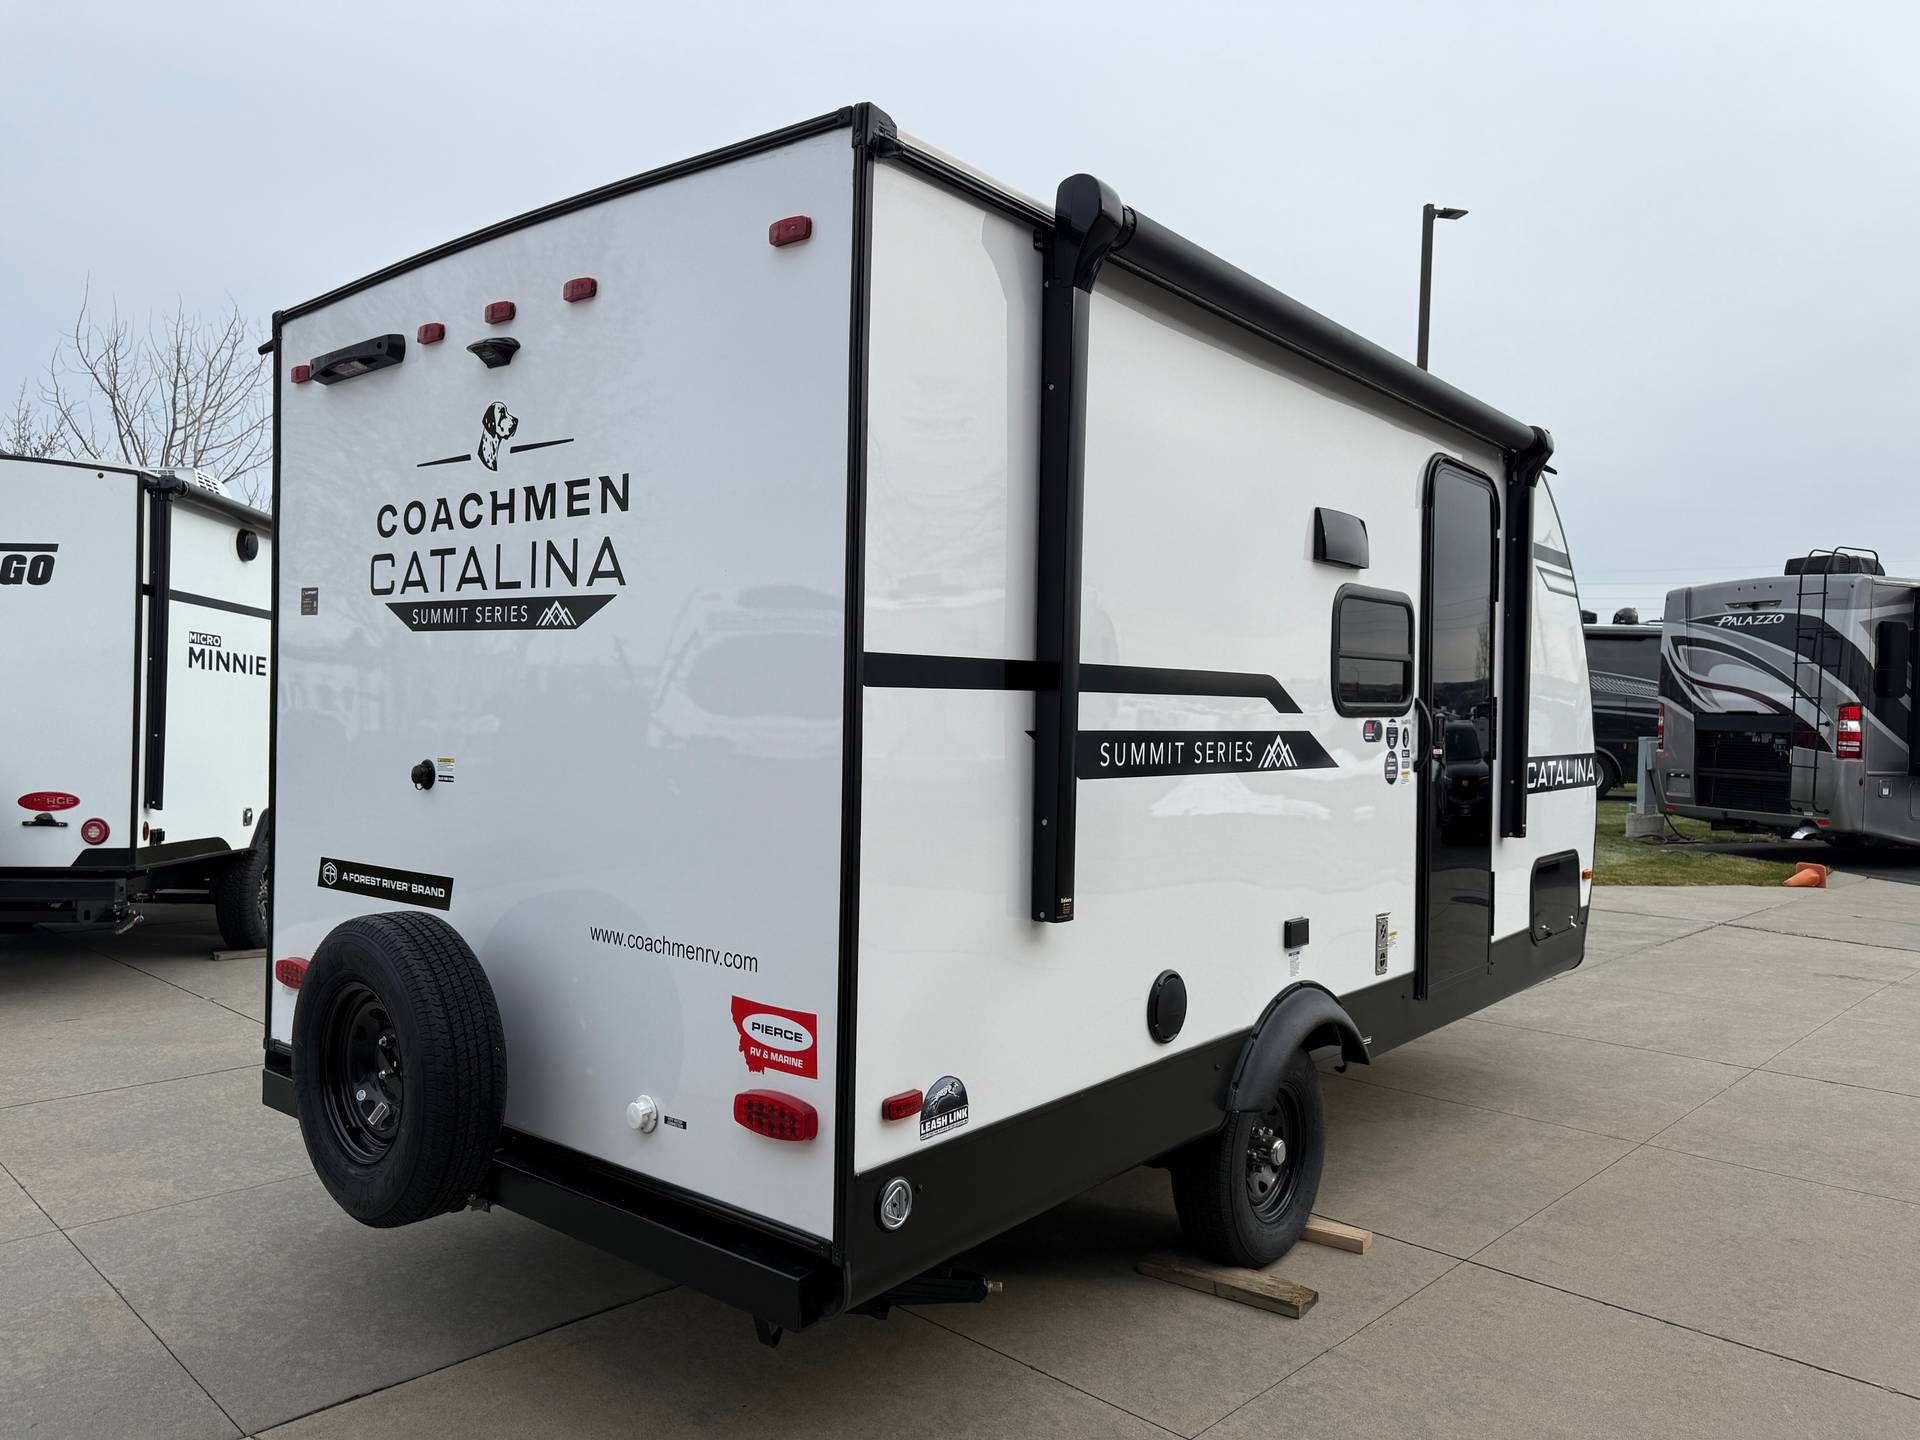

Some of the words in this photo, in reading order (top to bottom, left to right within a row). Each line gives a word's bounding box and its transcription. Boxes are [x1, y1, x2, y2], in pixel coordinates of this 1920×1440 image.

[376, 472, 630, 538] COACHMEN
[370, 536, 627, 596] CATALINA
[412, 606, 468, 625] SUMMIT
[475, 604, 529, 623] SERIES
[1715, 613, 1785, 627] PALAZZO
[189, 632, 221, 646] MICRO
[188, 646, 267, 676] MINNIE
[1099, 741, 1184, 767] SUMMIT
[1194, 740, 1253, 764] SERIES
[1527, 757, 1595, 789] CATALINA
[342, 872, 349, 881] A
[349, 873, 381, 887] FOREST
[411, 883, 445, 898] BRAND
[590, 925, 759, 973] www.coachmenrv.com
[751, 1021, 803, 1043] PIERCE
[750, 1047, 761, 1058] RV
[763, 1049, 769, 1059] &
[770, 1051, 803, 1069] MARINE
[921, 1115, 948, 1134] LEASH
[949, 1107, 968, 1123] LINK
